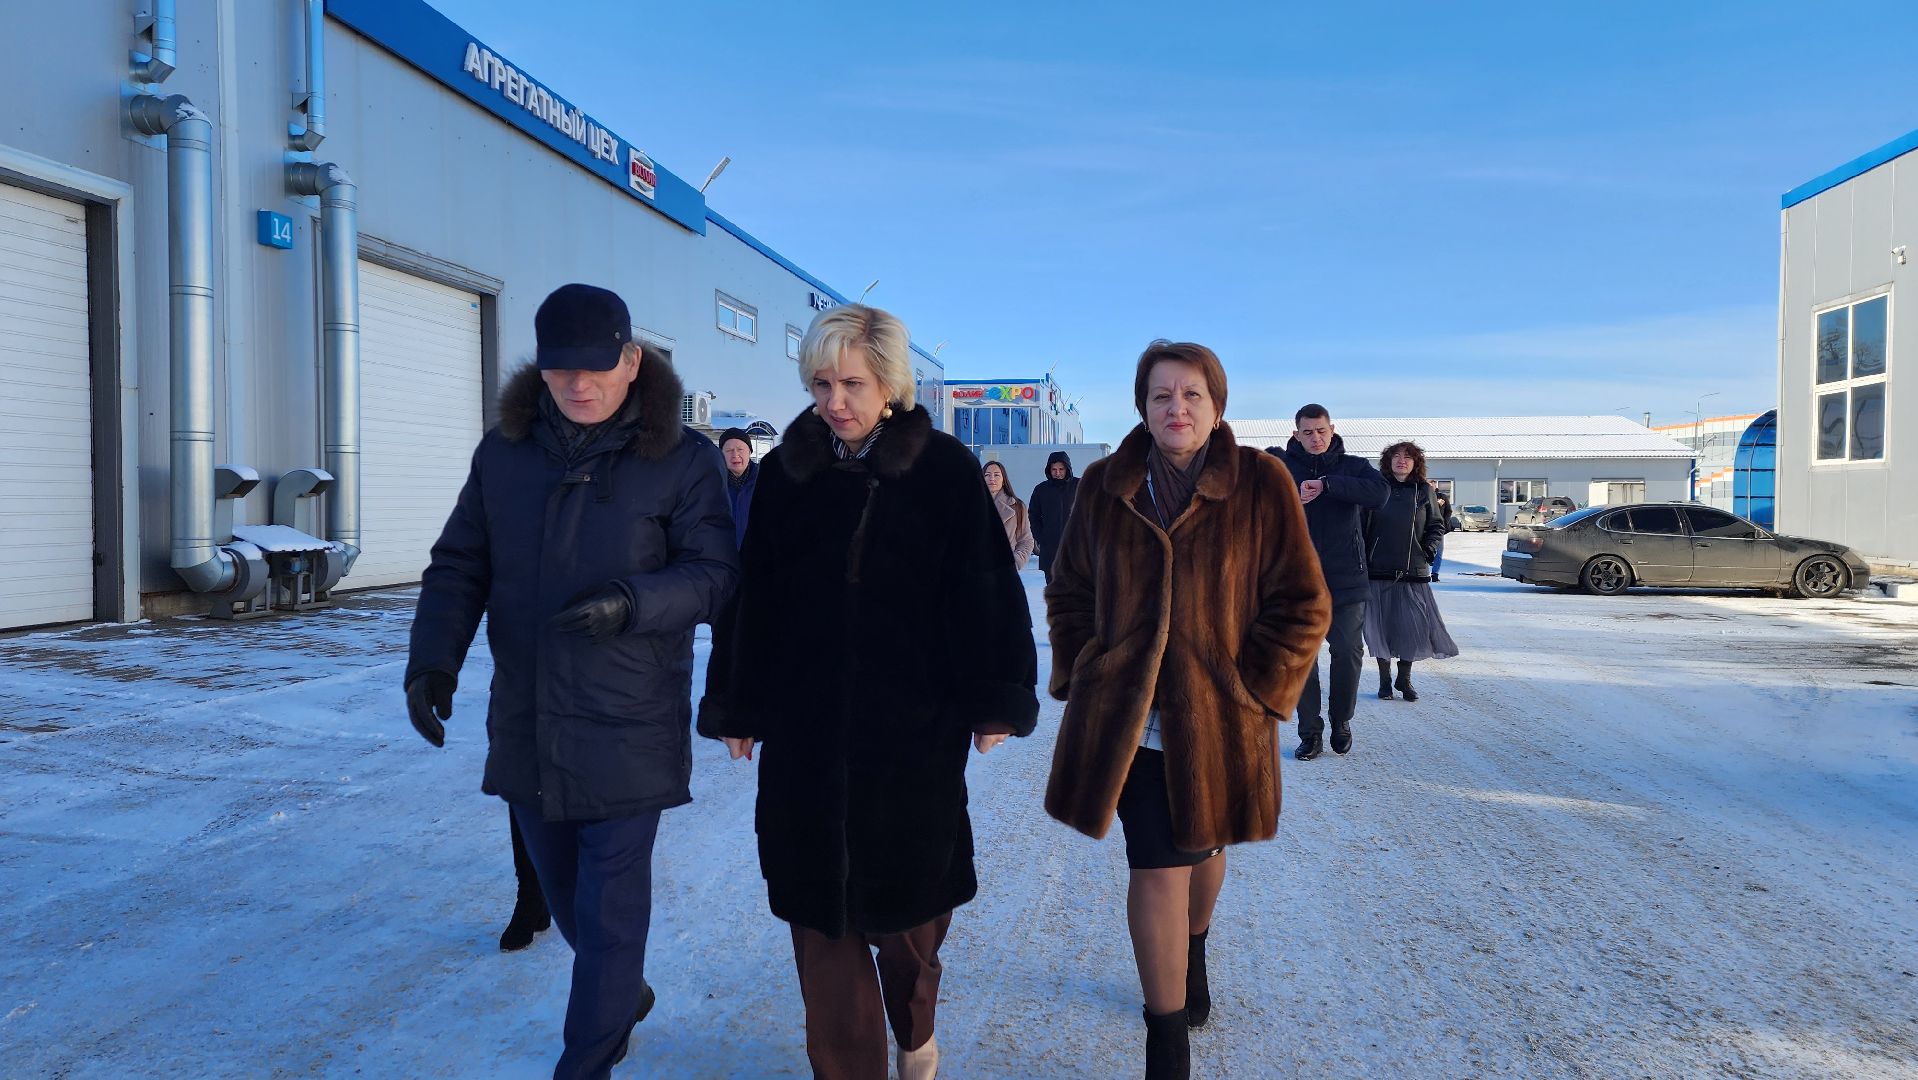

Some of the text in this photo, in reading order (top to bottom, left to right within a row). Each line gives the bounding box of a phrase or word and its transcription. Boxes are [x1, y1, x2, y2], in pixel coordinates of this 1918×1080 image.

[464, 42, 619, 165] АГРЕГАТНЫЙ ЦЕХ
[273, 217, 292, 243] 14
